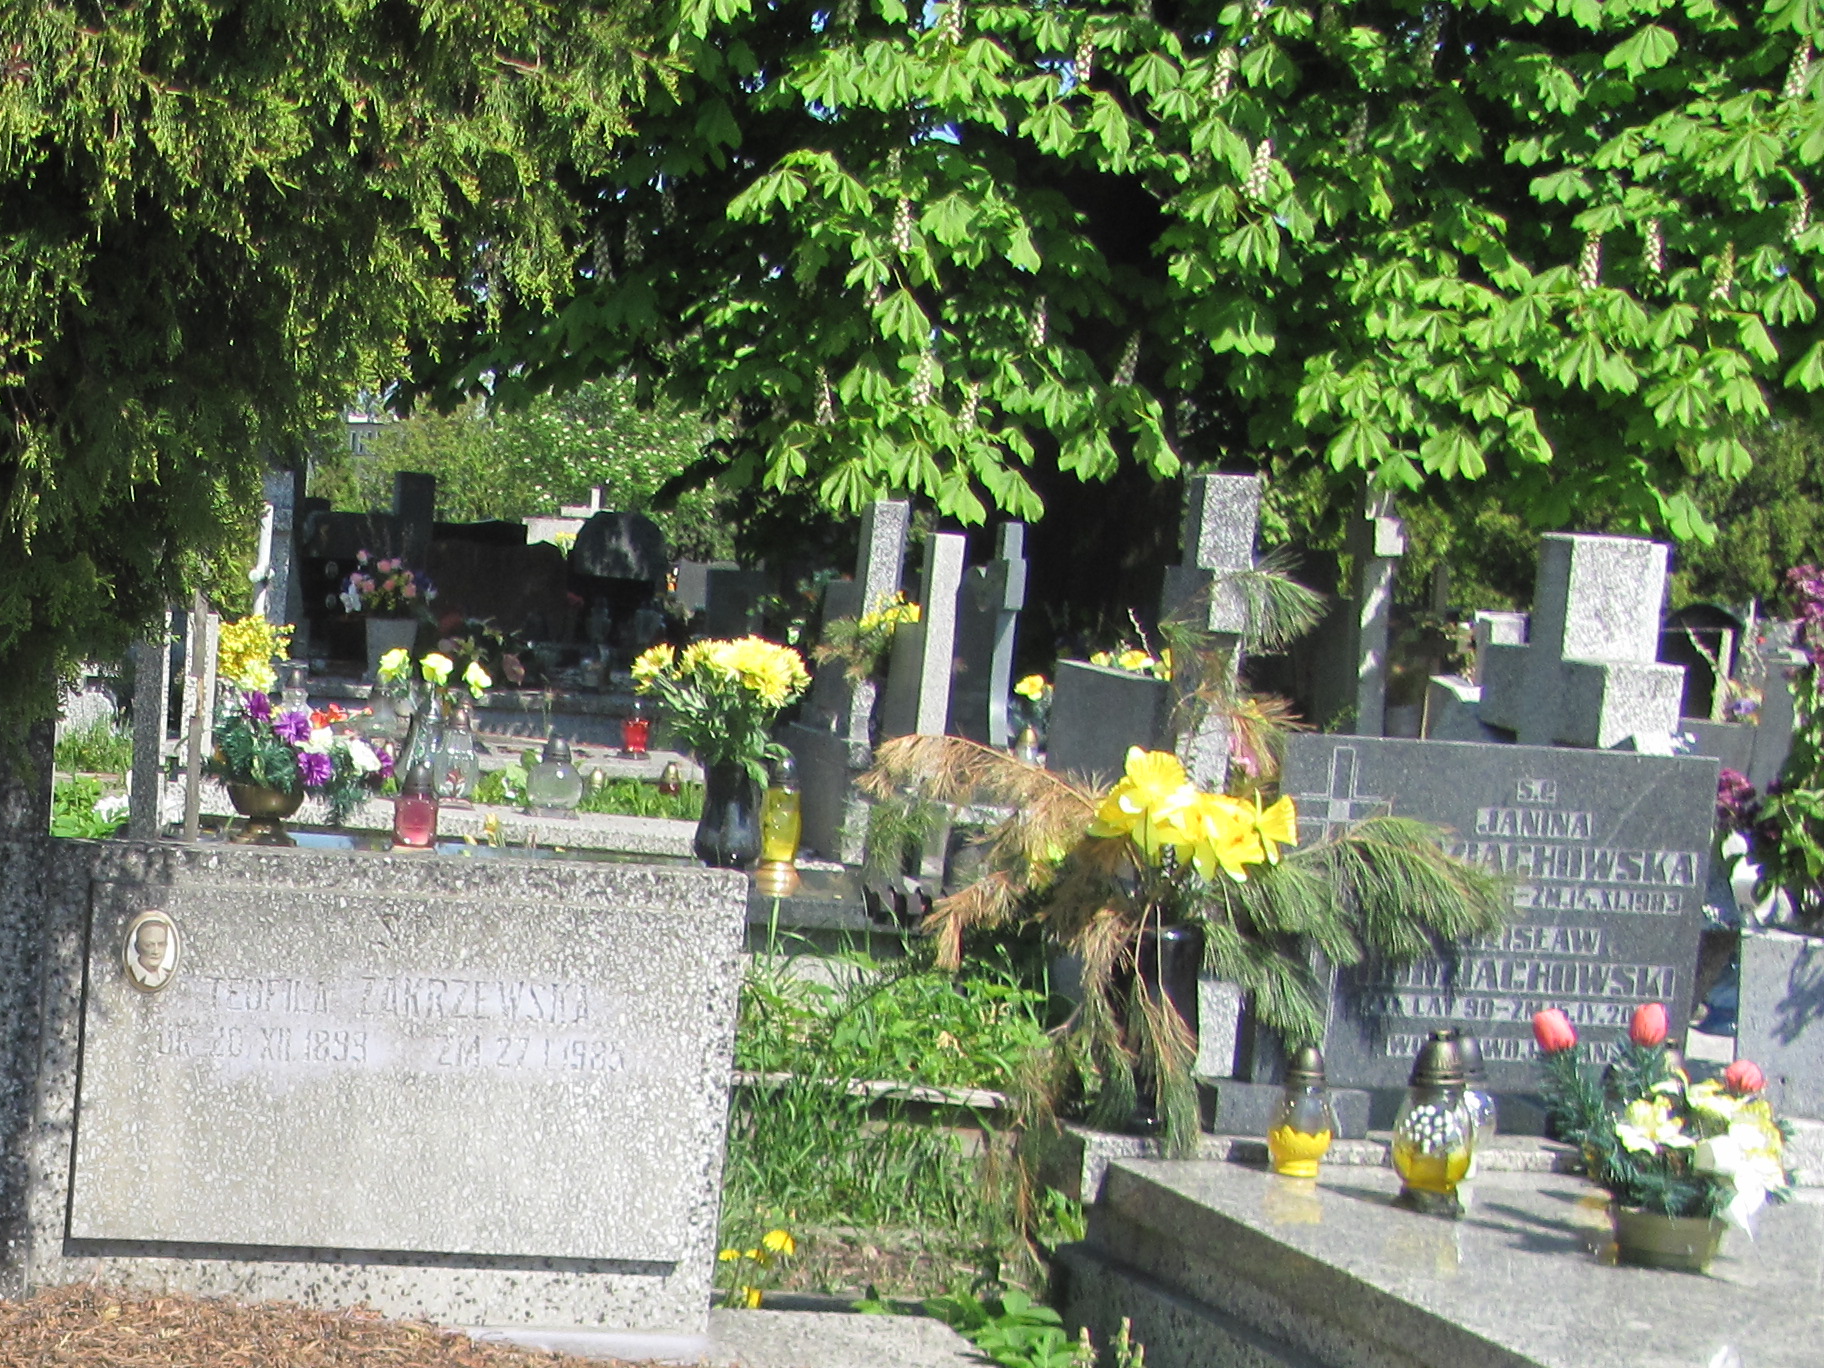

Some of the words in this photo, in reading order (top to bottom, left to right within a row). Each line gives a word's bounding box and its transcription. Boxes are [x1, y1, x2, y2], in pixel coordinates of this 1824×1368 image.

[1476, 808, 1593, 839] JANINA
[204, 975, 329, 1014] TEOFILA
[360, 975, 590, 1025] ZAKRZEWSKA
